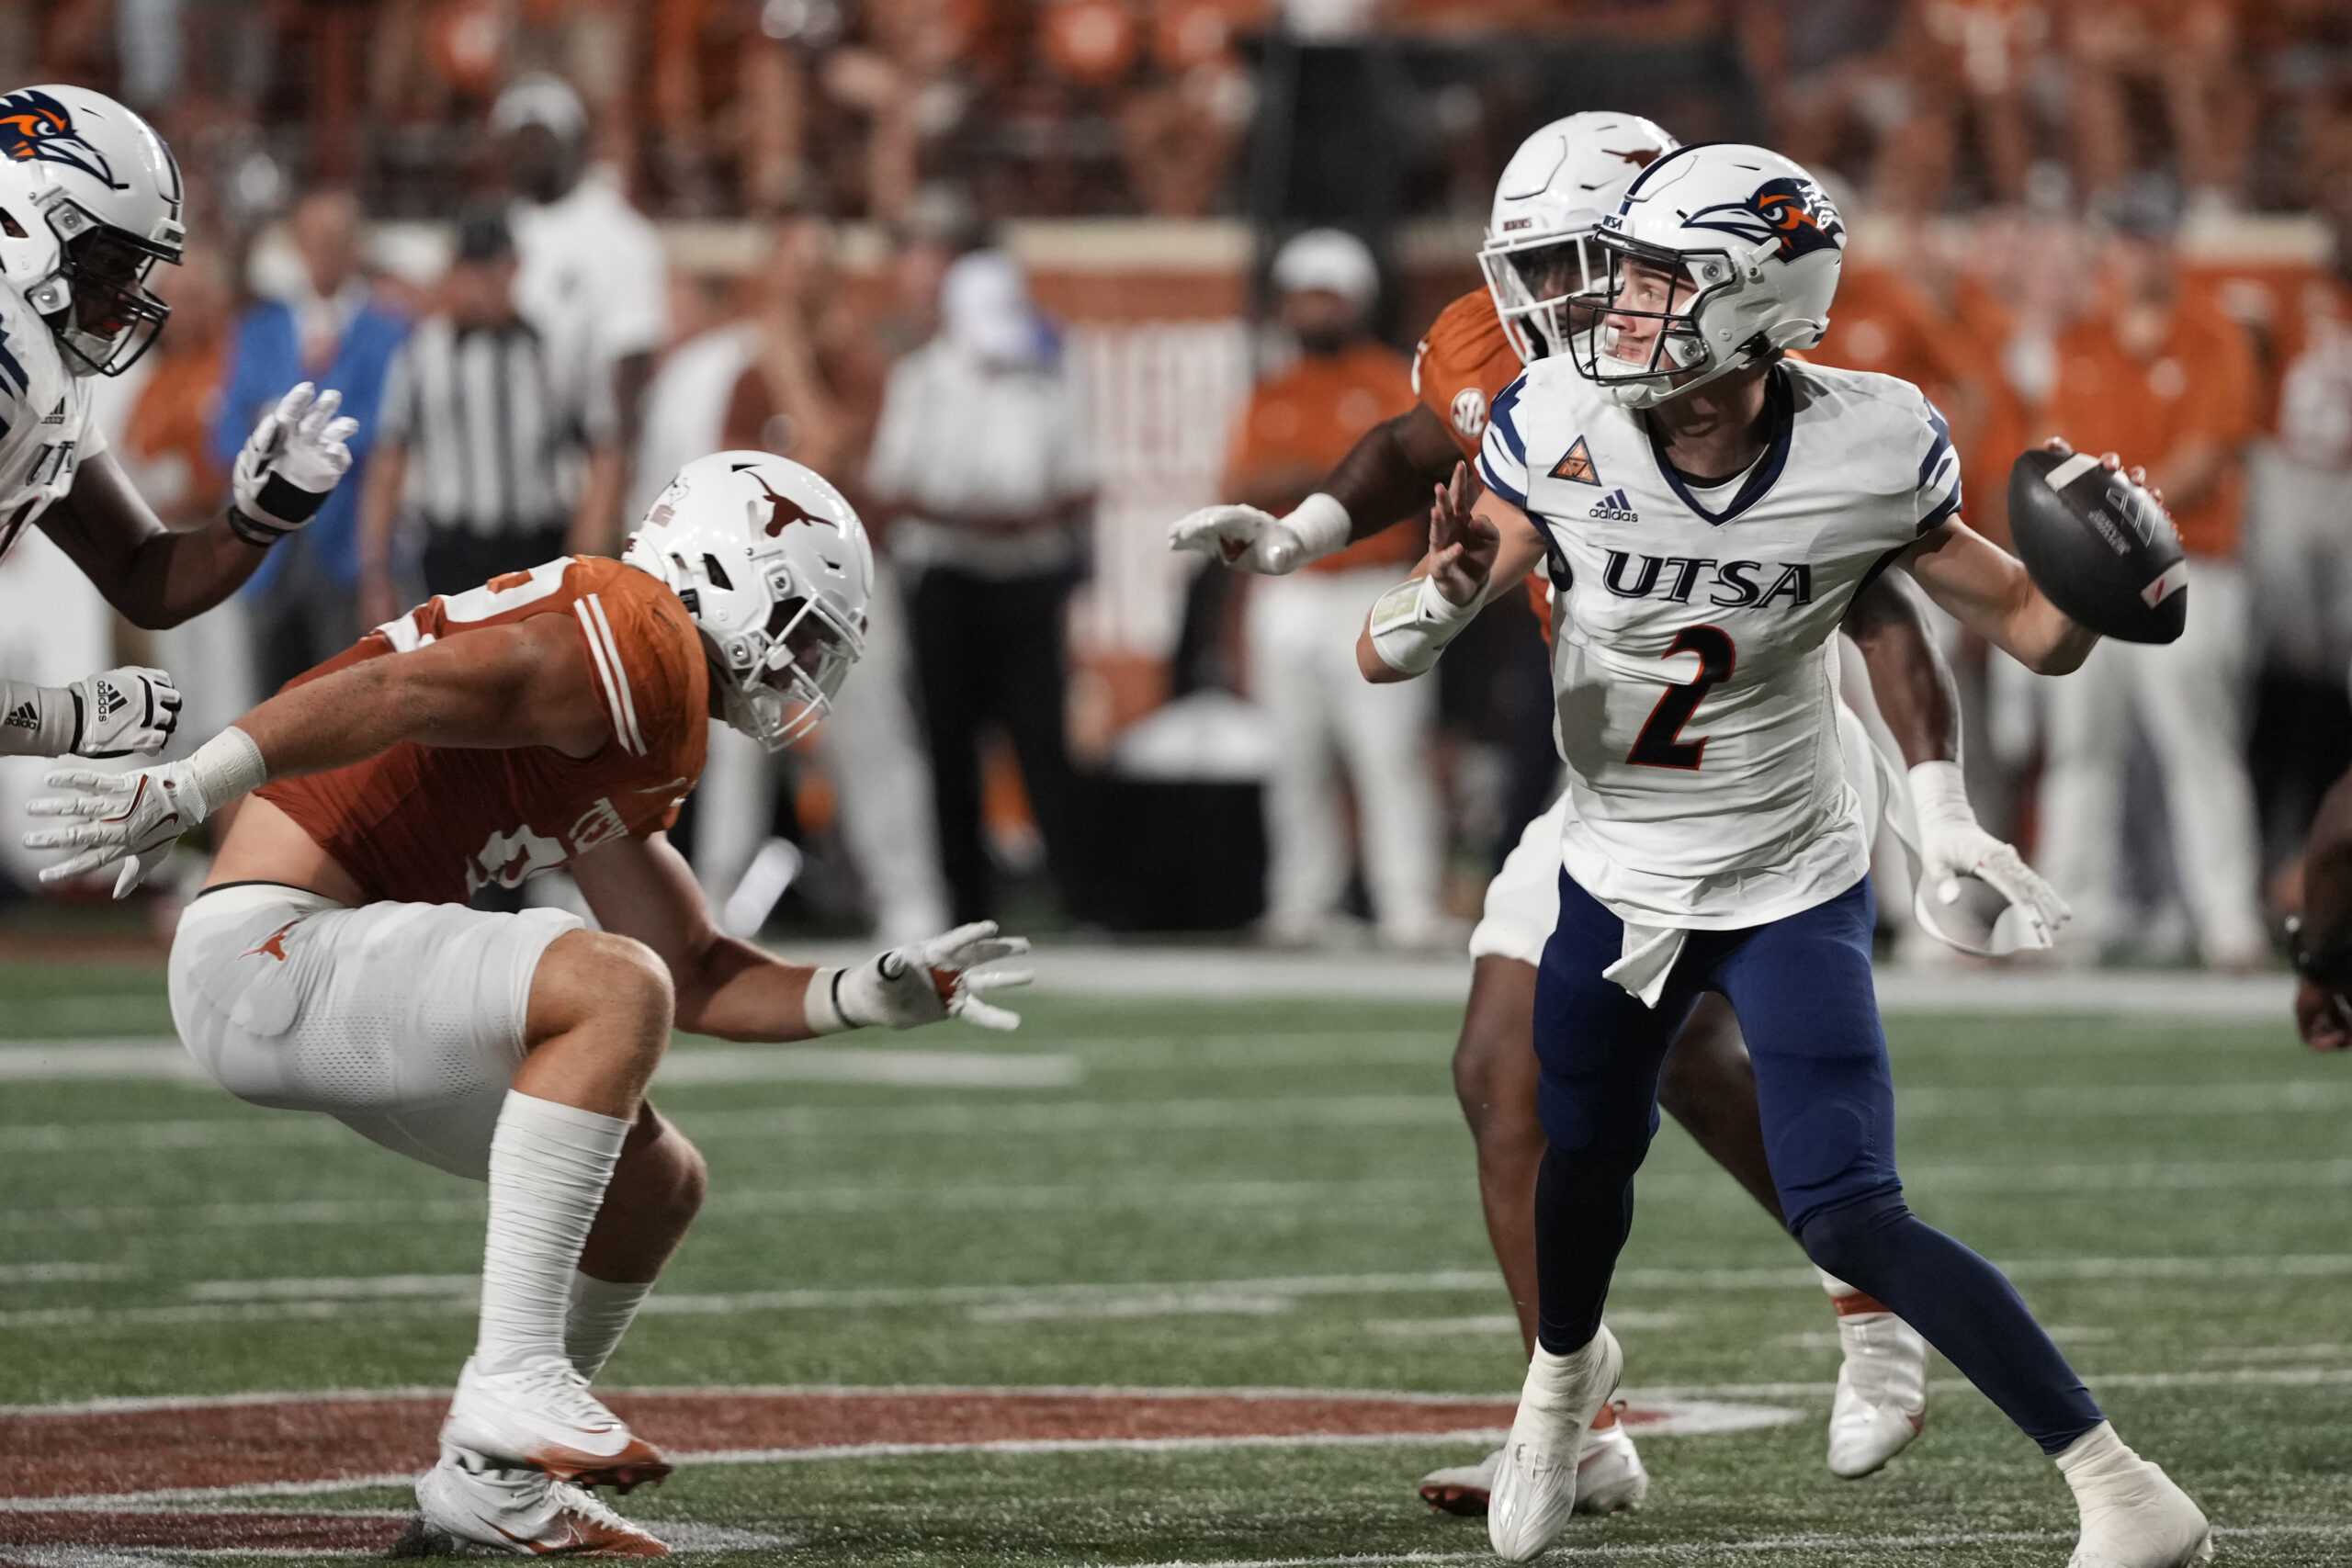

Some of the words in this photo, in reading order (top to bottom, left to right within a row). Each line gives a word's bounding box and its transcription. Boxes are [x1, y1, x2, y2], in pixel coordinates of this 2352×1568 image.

[1589, 506, 1639, 523] adidas
[1603, 548, 1814, 609] UTSA
[97, 681, 109, 722] adidas
[1625, 625, 1736, 770] 2
[5, 716, 37, 729] adida
